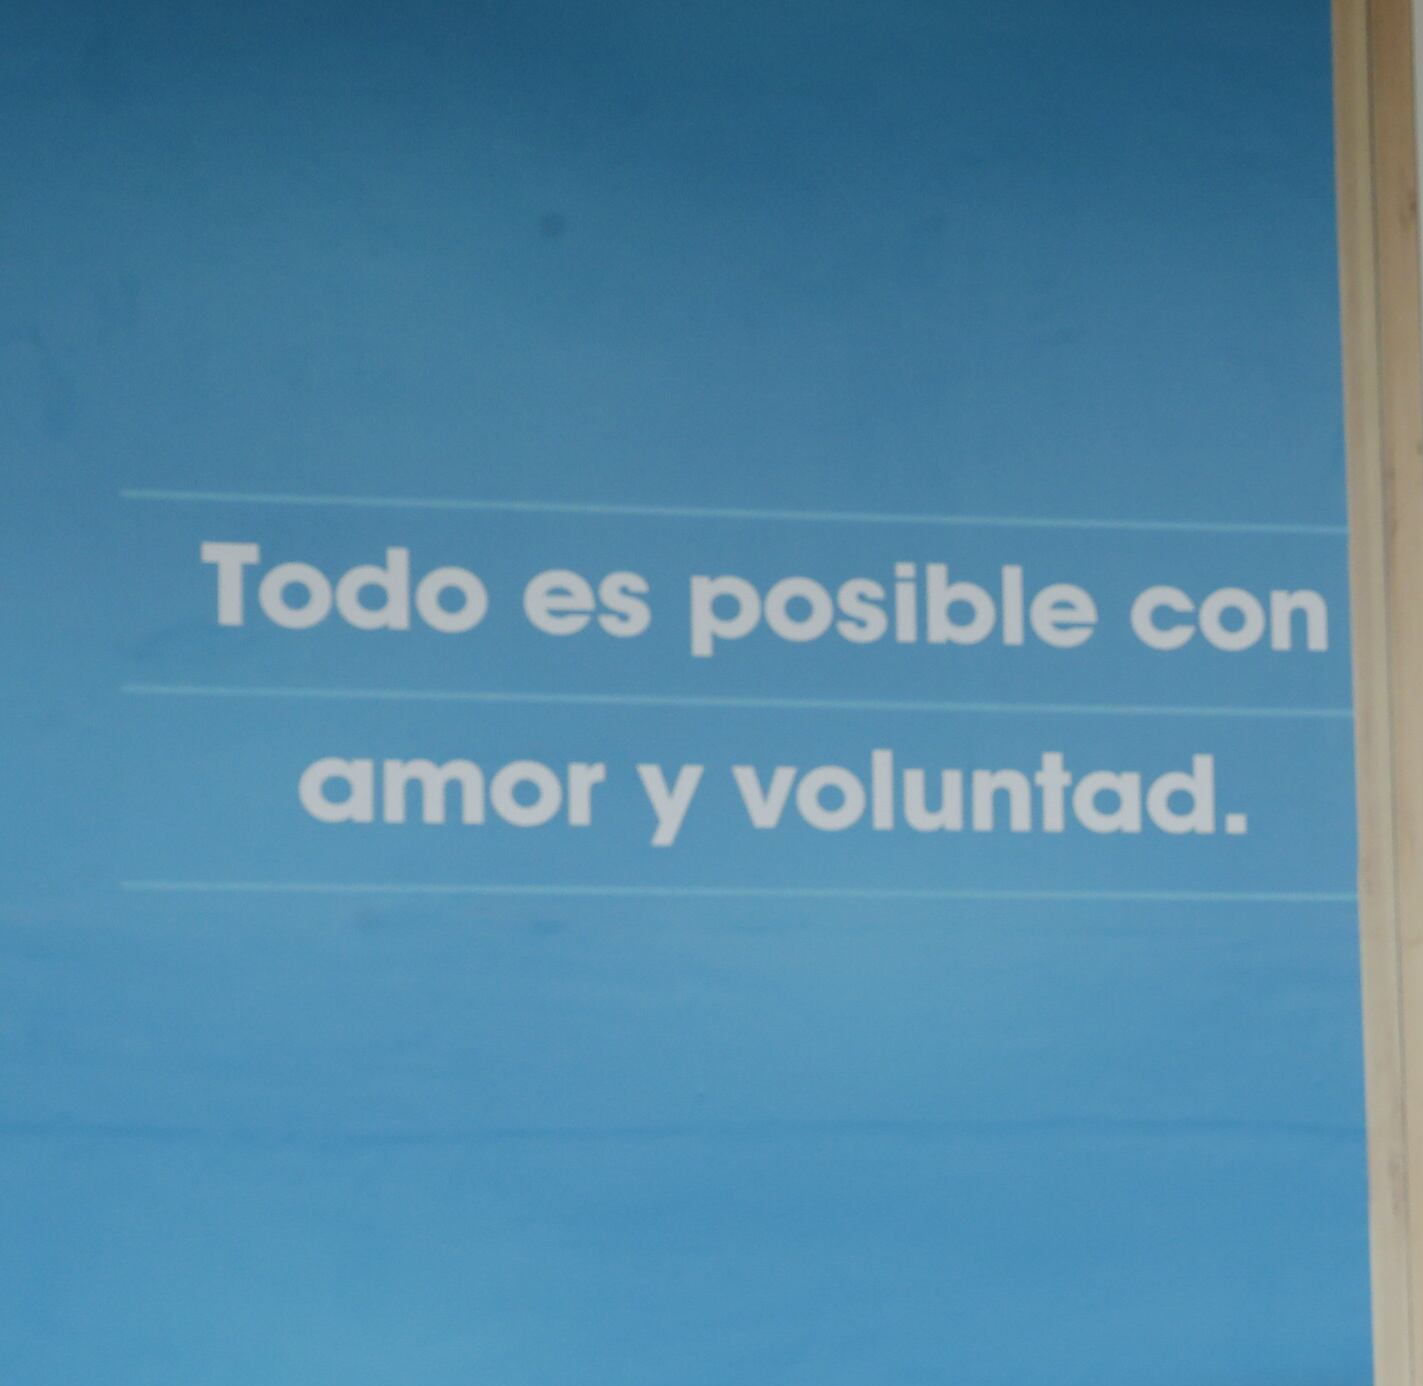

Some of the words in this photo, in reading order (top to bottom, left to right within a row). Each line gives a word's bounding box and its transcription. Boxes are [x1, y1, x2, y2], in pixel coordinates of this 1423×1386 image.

[201, 541, 489, 633] Todo
[523, 568, 651, 638] es
[690, 561, 1098, 658] posible
[1130, 584, 1329, 652] con
[299, 757, 606, 827] amor
[636, 763, 704, 846] y
[732, 749, 1248, 835] voluntad.
